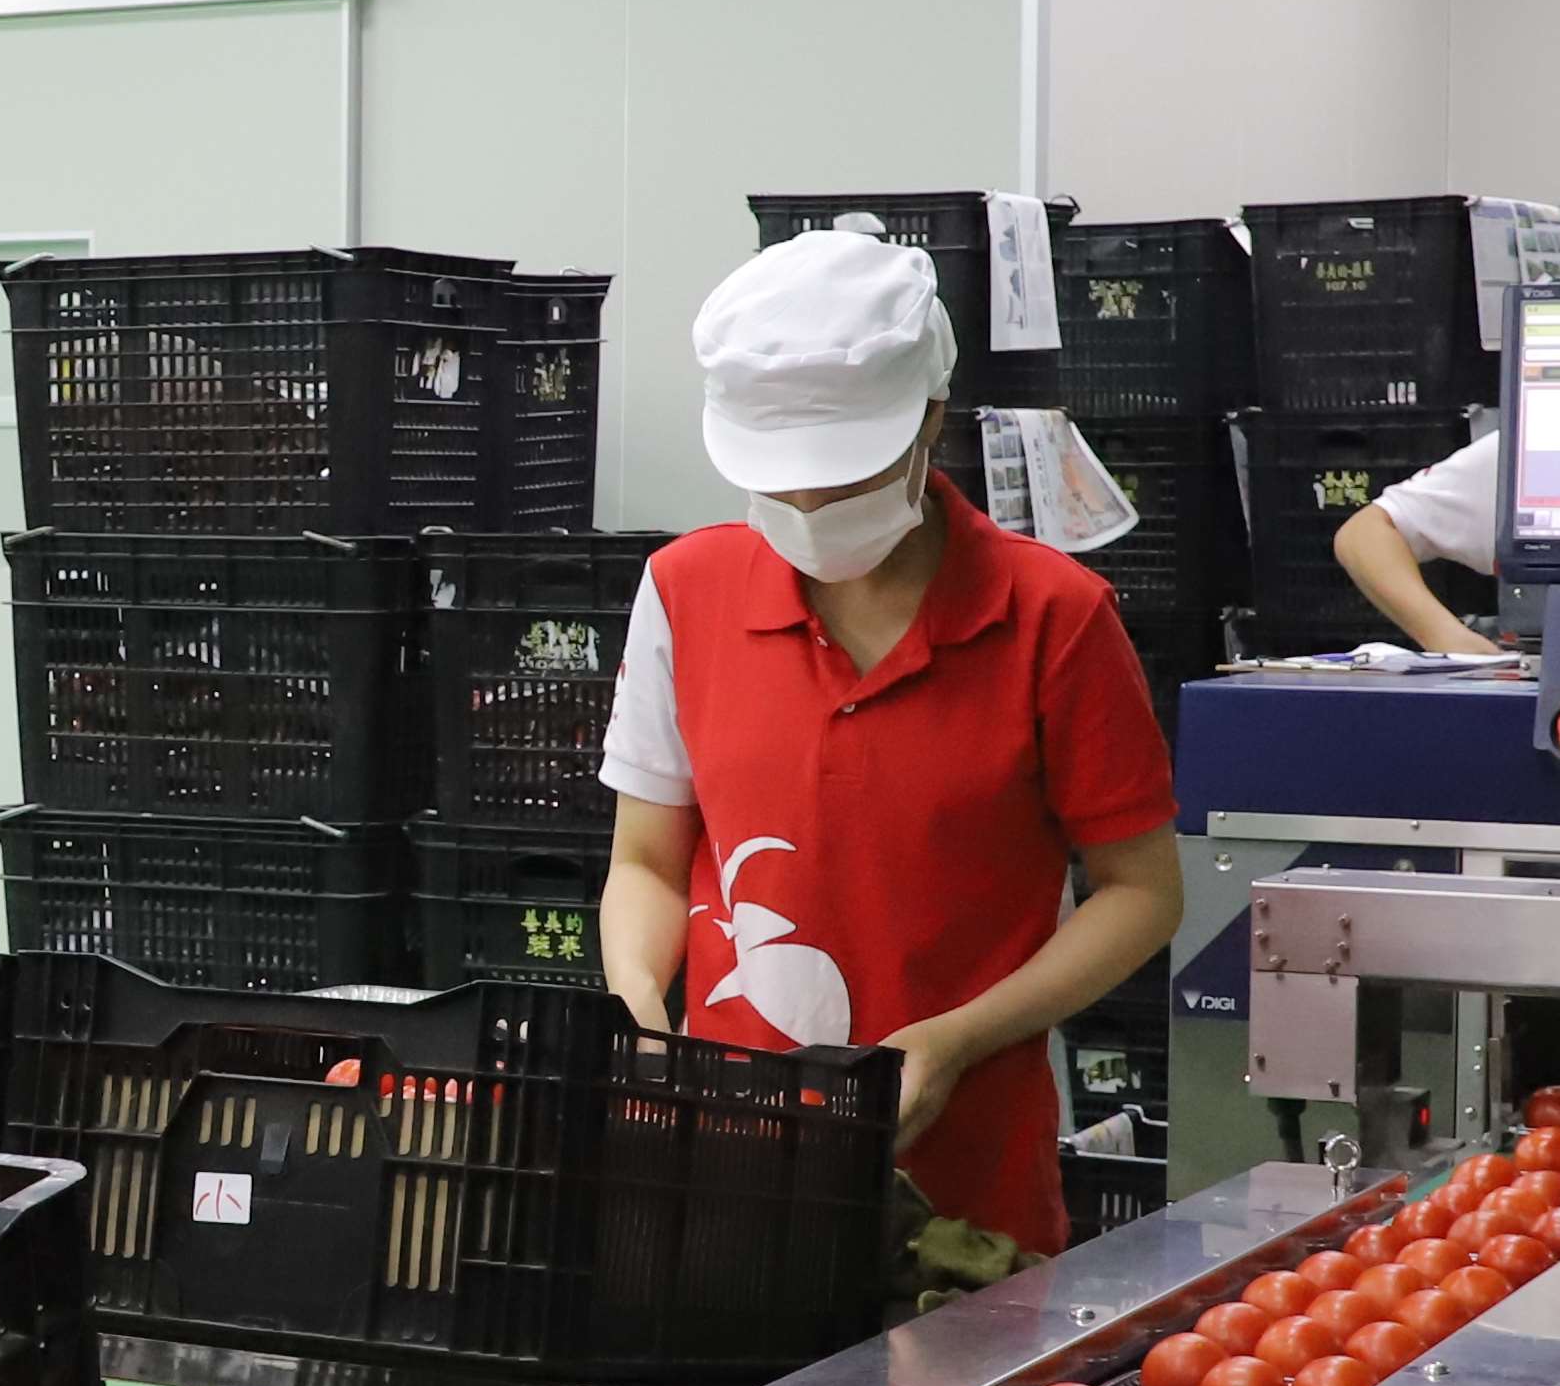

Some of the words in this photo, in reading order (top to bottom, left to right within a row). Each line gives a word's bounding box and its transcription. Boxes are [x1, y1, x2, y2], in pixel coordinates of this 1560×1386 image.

[521, 909, 582, 934] 善美的
[526, 934, 584, 961] 蔬果
[1201, 995, 1236, 1011] DIGI
[195, 1179, 243, 1220] 小
